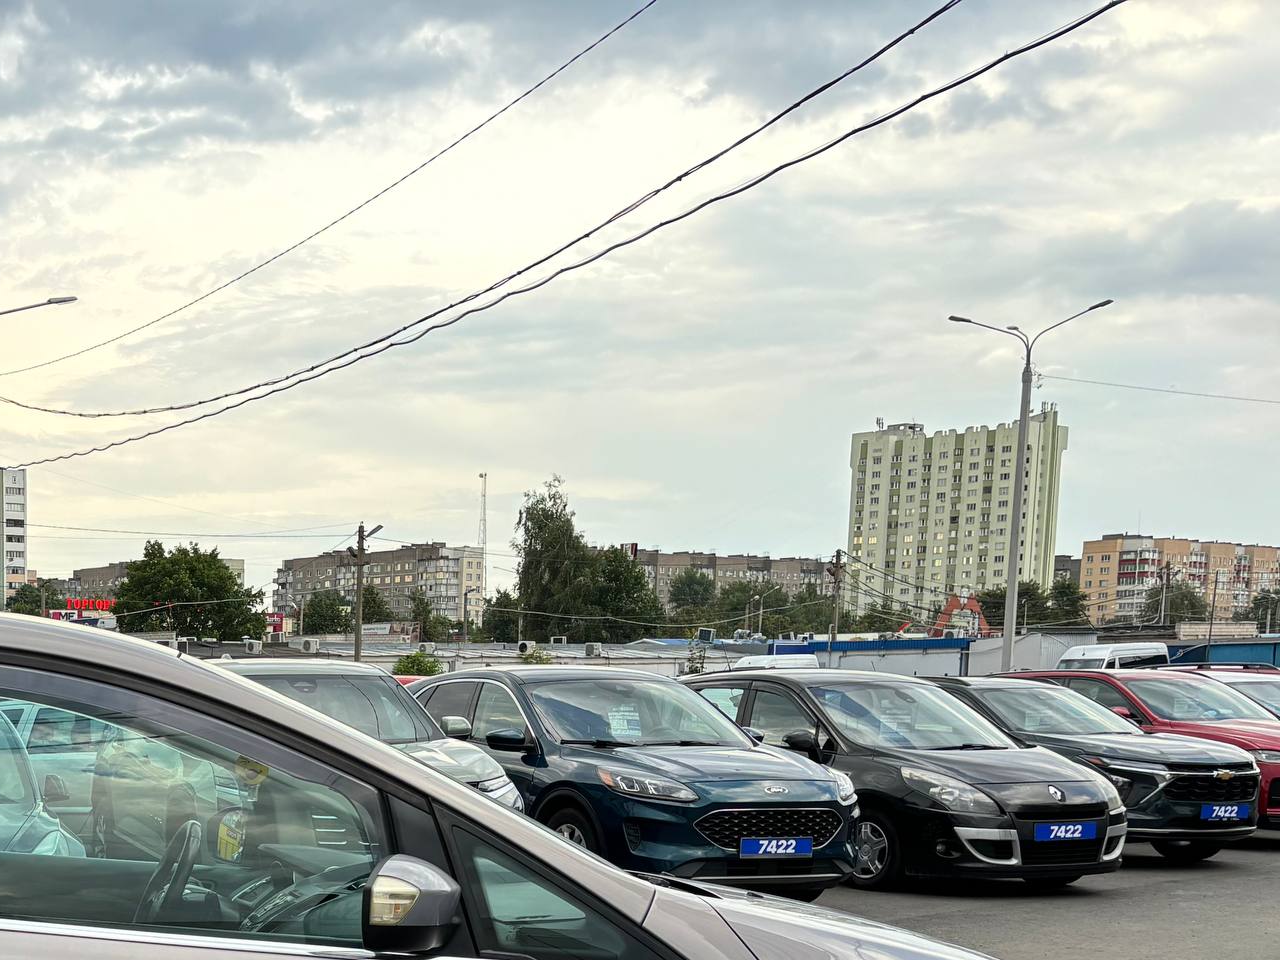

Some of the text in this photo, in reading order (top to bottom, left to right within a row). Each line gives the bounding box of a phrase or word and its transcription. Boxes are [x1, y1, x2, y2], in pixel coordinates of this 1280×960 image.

[1212, 805, 1239, 818] 7422
[1050, 824, 1083, 839] 7422
[758, 839, 797, 854] 7422
